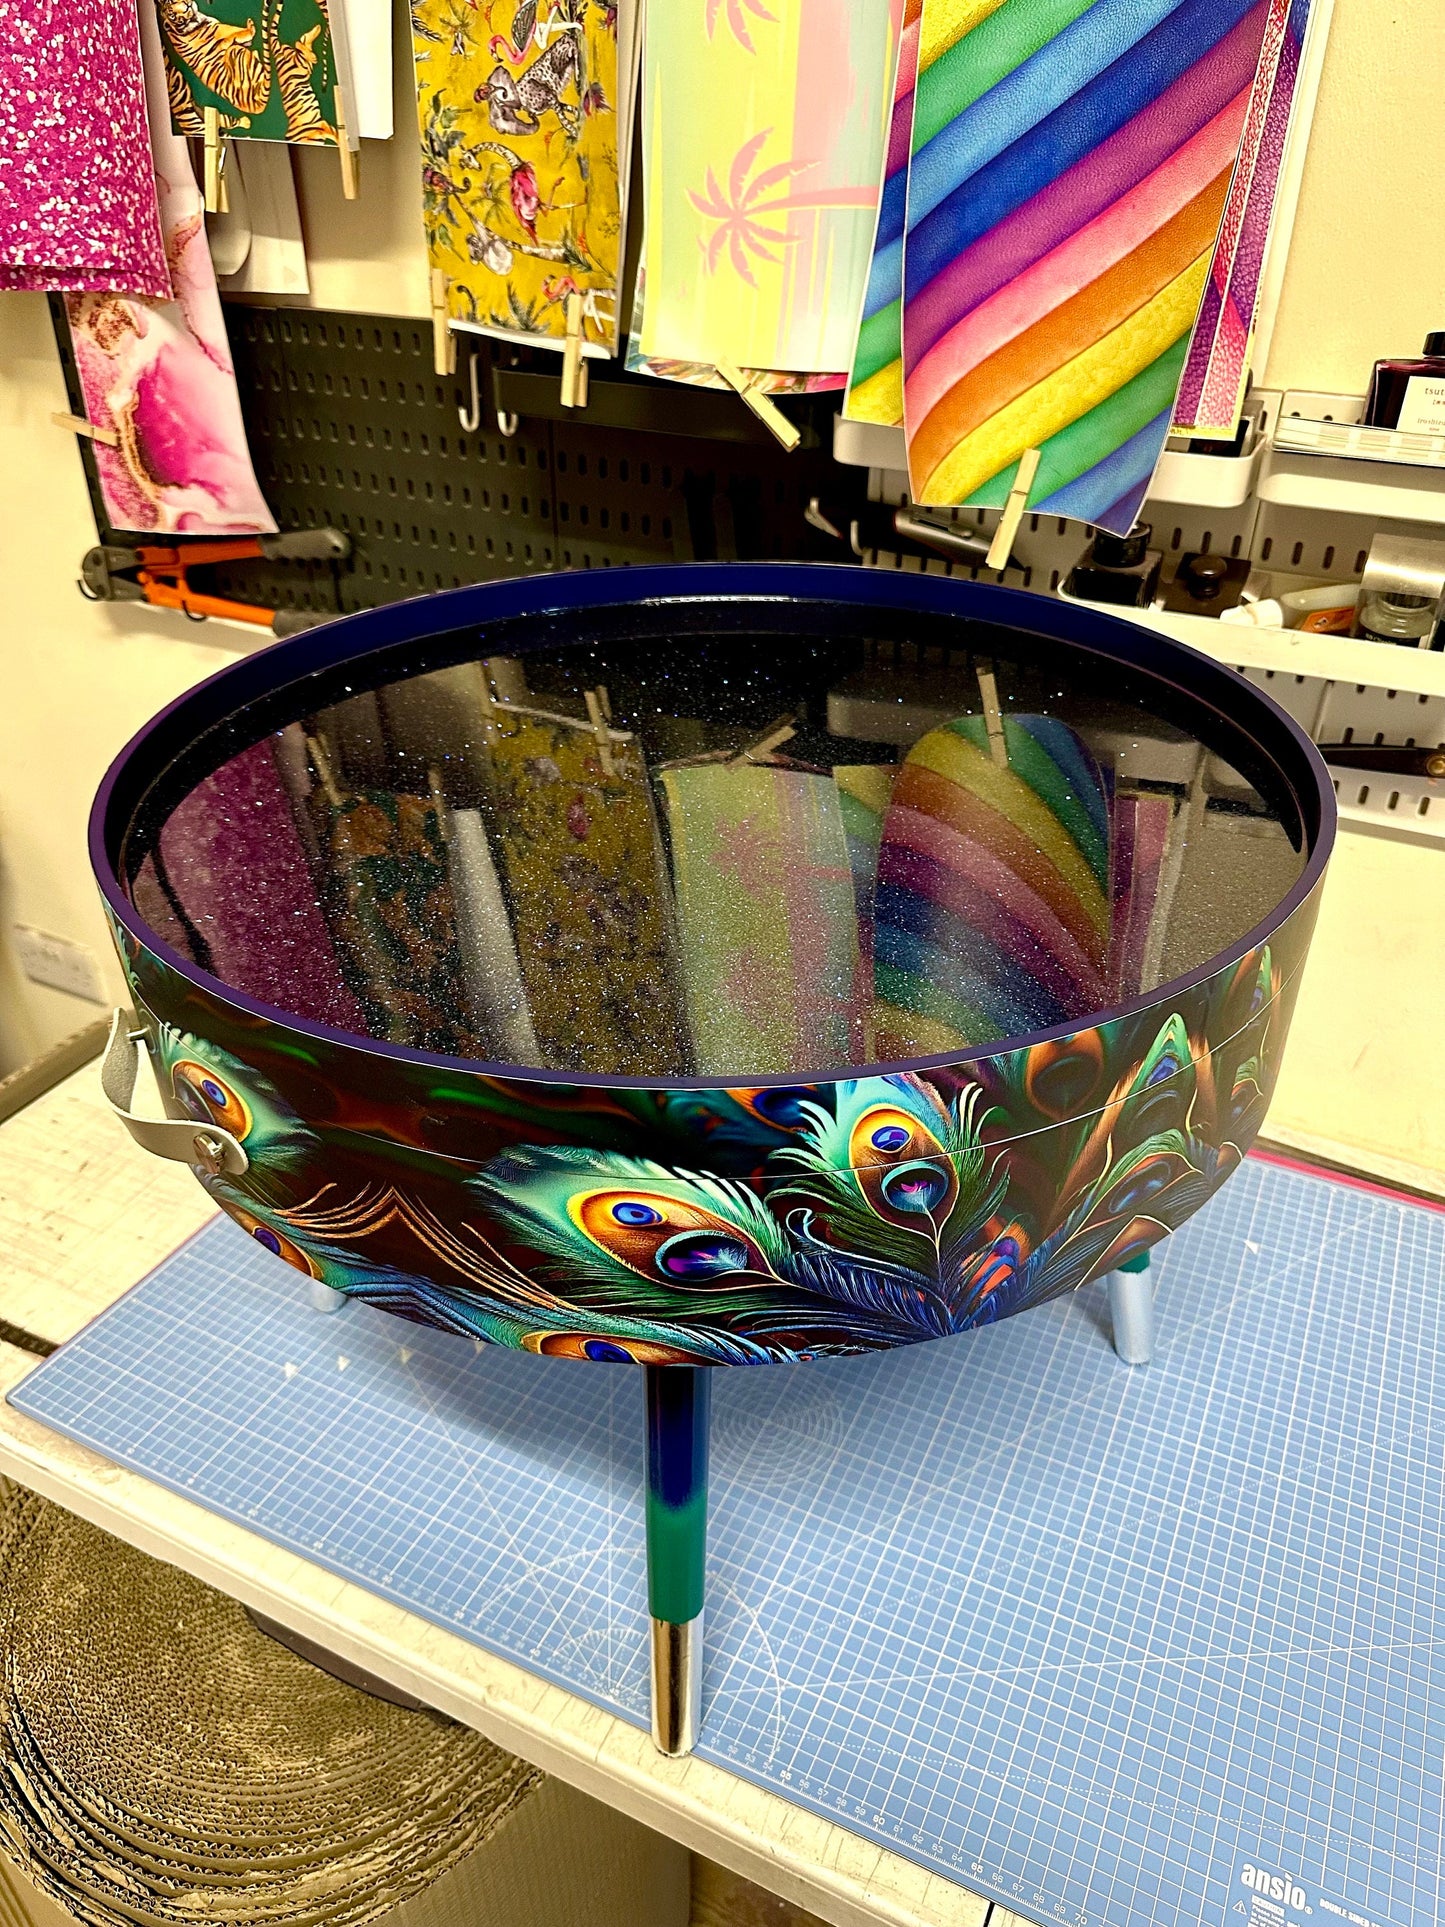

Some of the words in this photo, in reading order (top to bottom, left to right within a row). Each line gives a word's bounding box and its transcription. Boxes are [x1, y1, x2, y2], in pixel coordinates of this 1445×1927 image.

[762, 1761, 774, 1772] 54
[780, 1769, 792, 1780] 55
[799, 1778, 810, 1789] 56
[817, 1787, 829, 1798] 57
[835, 1796, 848, 1807] 58
[854, 1805, 867, 1816] 59
[872, 1814, 886, 1826] 60
[893, 1824, 904, 1834] 61
[912, 1833, 925, 1845] 62
[931, 1842, 944, 1854] 63
[951, 1852, 963, 1863] 64
[991, 1872, 1004, 1883] 66
[1012, 1882, 1025, 1893] 67
[1074, 1912, 1088, 1925] 70
